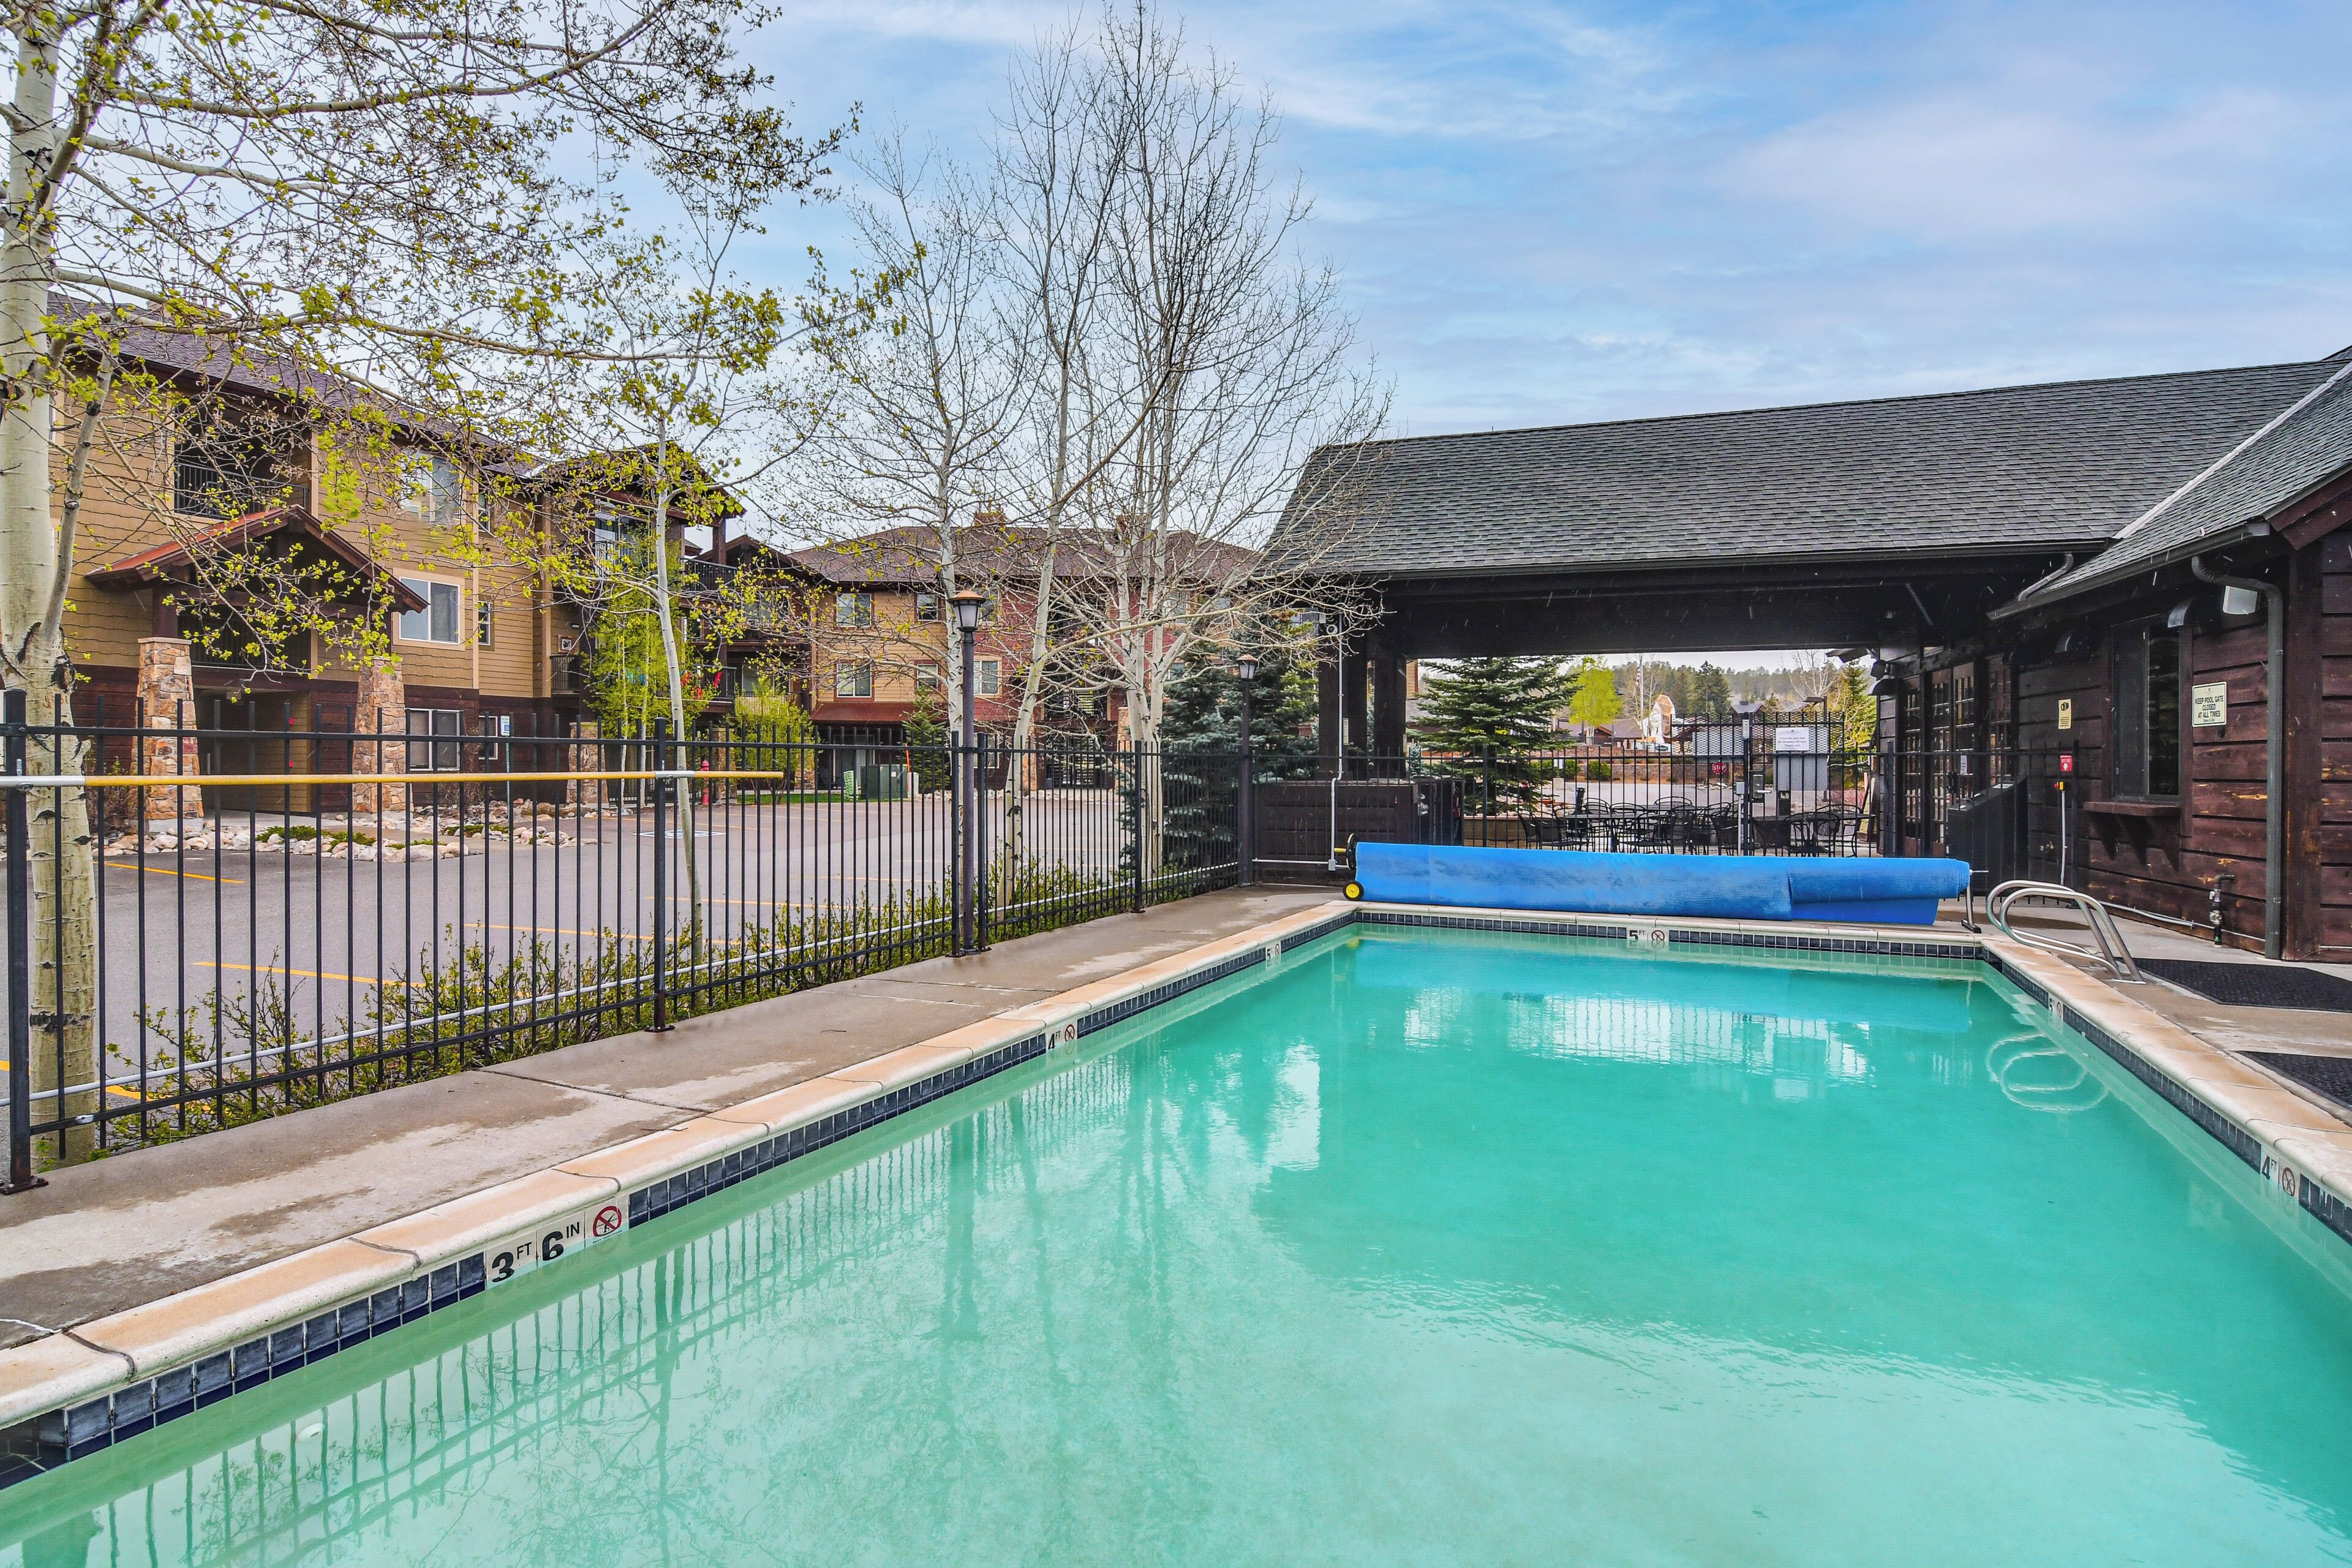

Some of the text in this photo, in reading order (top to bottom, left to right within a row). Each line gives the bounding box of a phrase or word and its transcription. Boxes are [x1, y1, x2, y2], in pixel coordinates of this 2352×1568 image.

[1629, 930, 1638, 940] 5
[1048, 1030, 1061, 1049] 4 FT
[2261, 1155, 2277, 1180] 4 FT
[492, 1221, 580, 1283] 3 FT 6 IN
